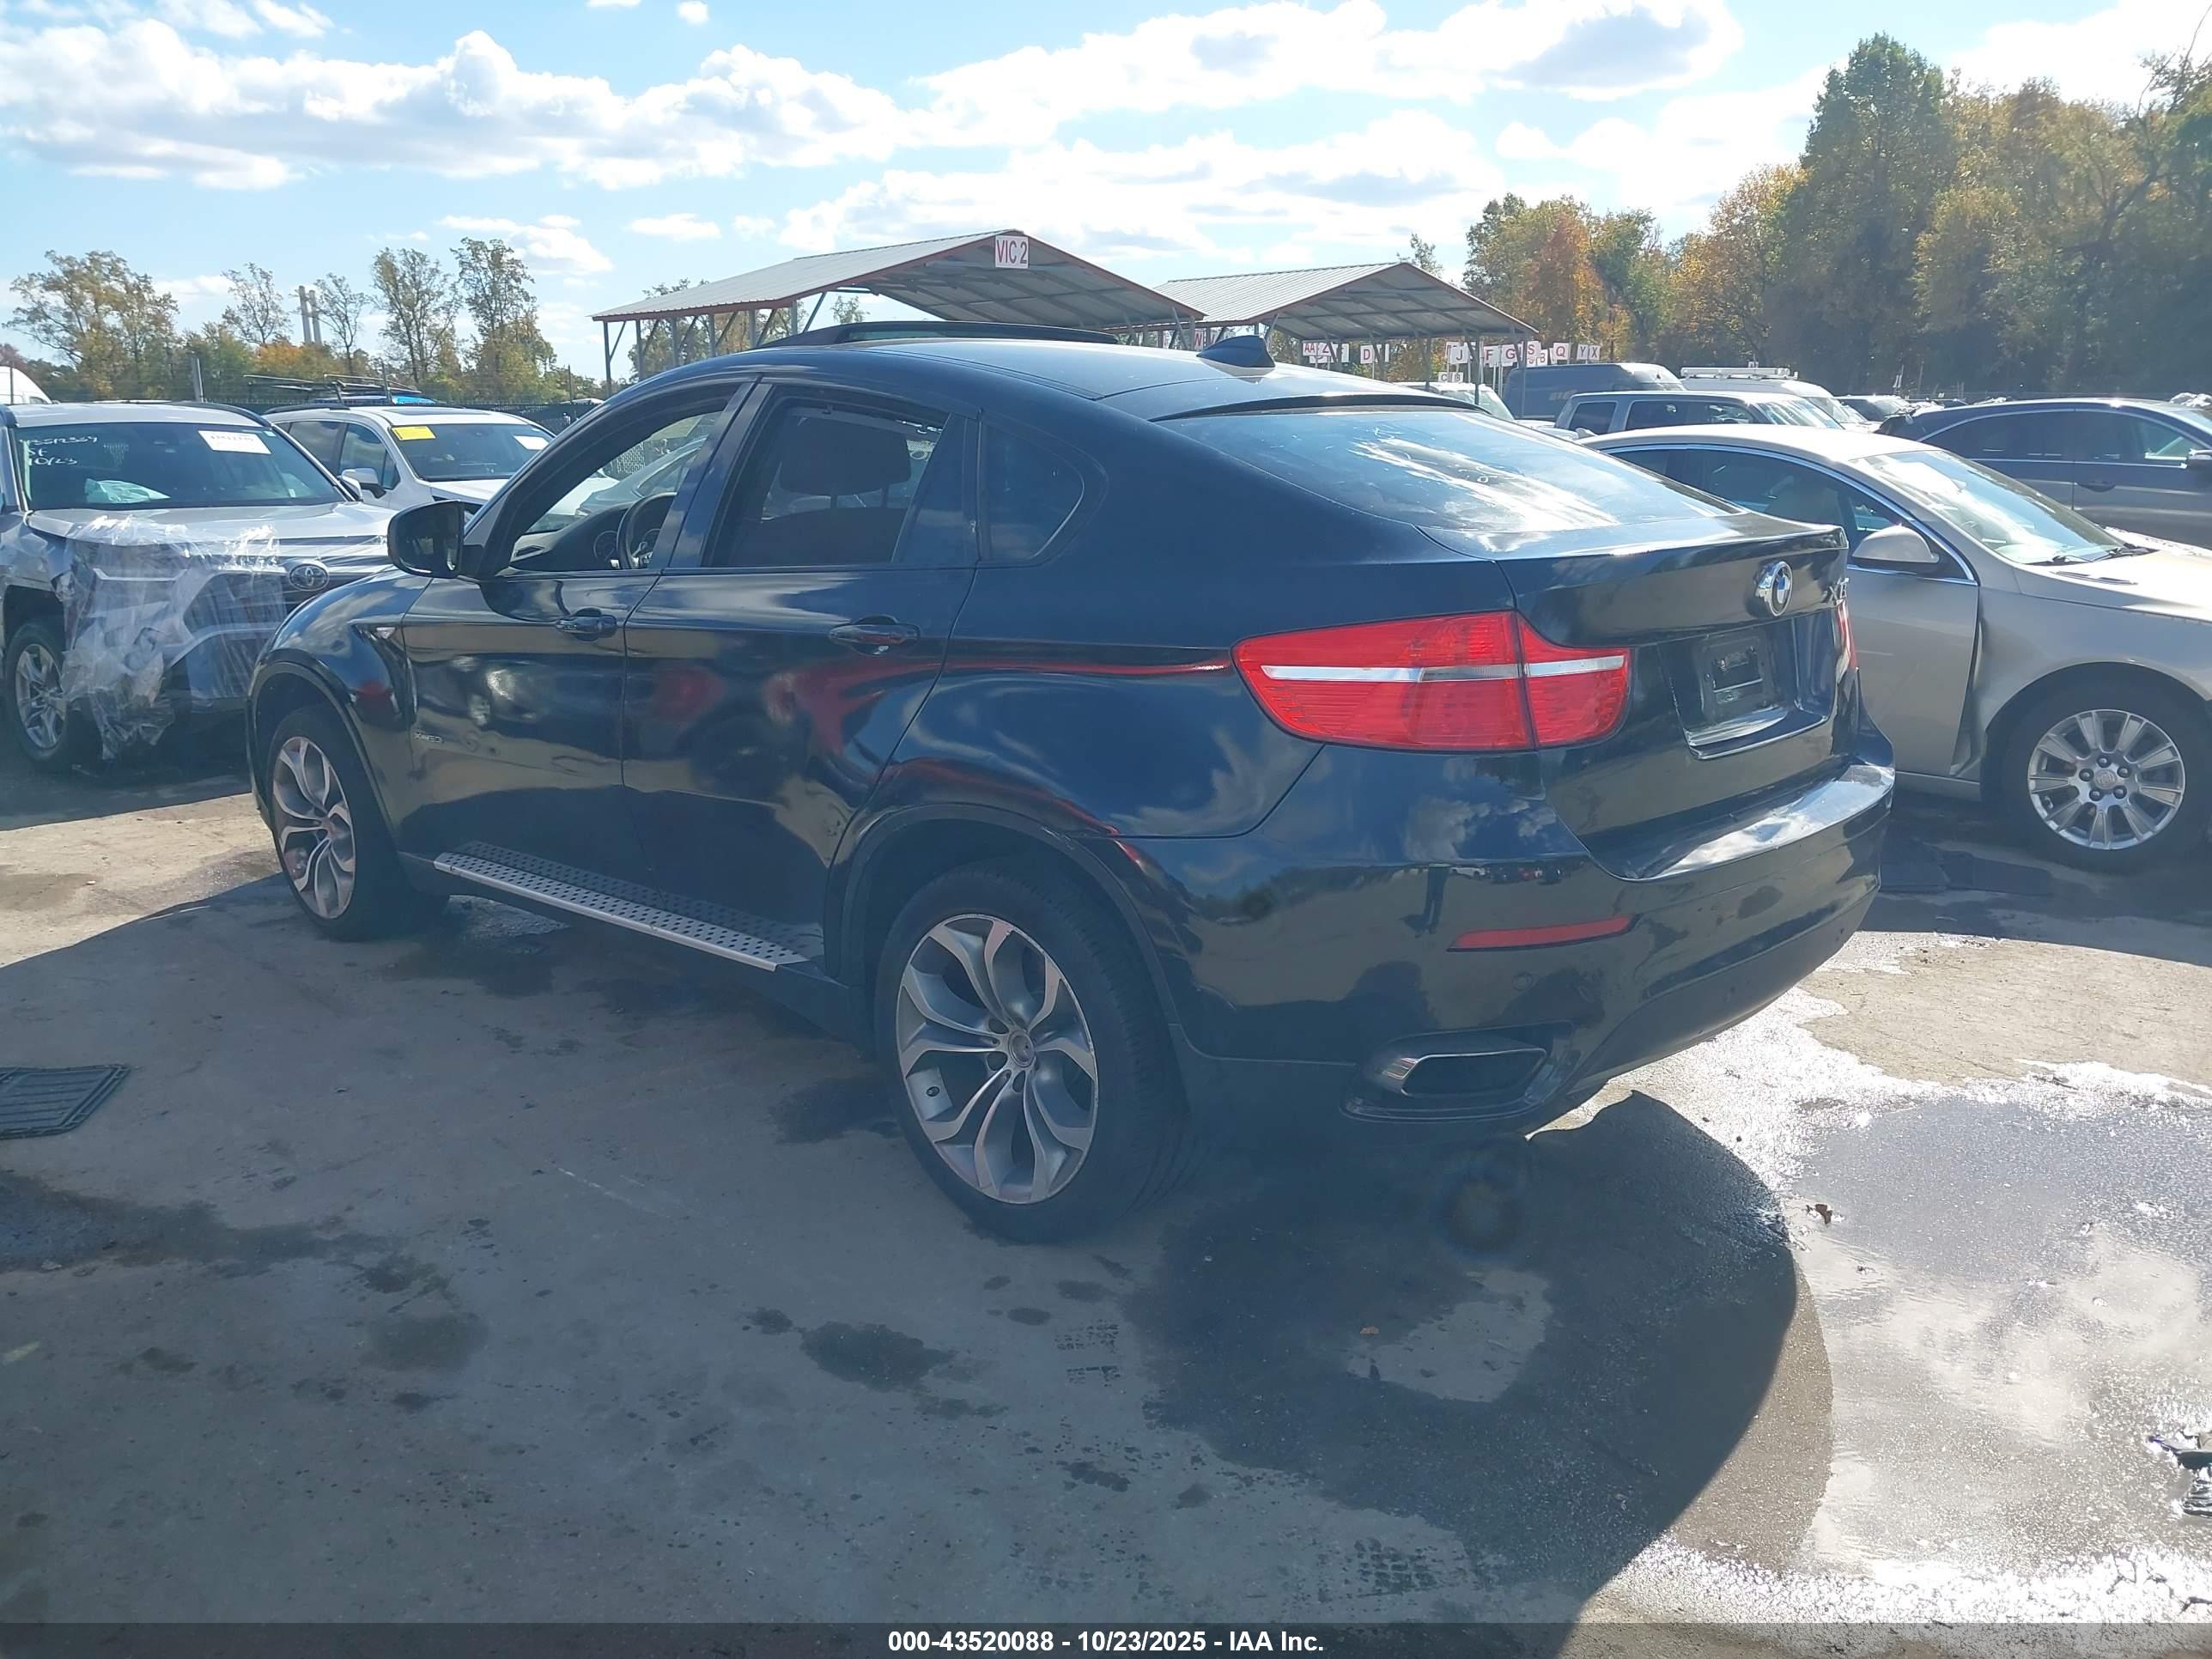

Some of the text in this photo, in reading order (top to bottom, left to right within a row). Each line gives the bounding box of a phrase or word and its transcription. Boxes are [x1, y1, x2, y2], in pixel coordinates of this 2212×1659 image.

[997, 240, 1028, 264] VIC 2
[1304, 343, 1316, 354] AA
[1363, 349, 1370, 360] D
[1505, 348, 1516, 360] G
[1528, 343, 1535, 356] S
[1555, 345, 1565, 358] Q
[1579, 346, 1586, 357] Y
[1591, 346, 1598, 358] X
[1455, 349, 1463, 361] J
[1486, 349, 1493, 361] F
